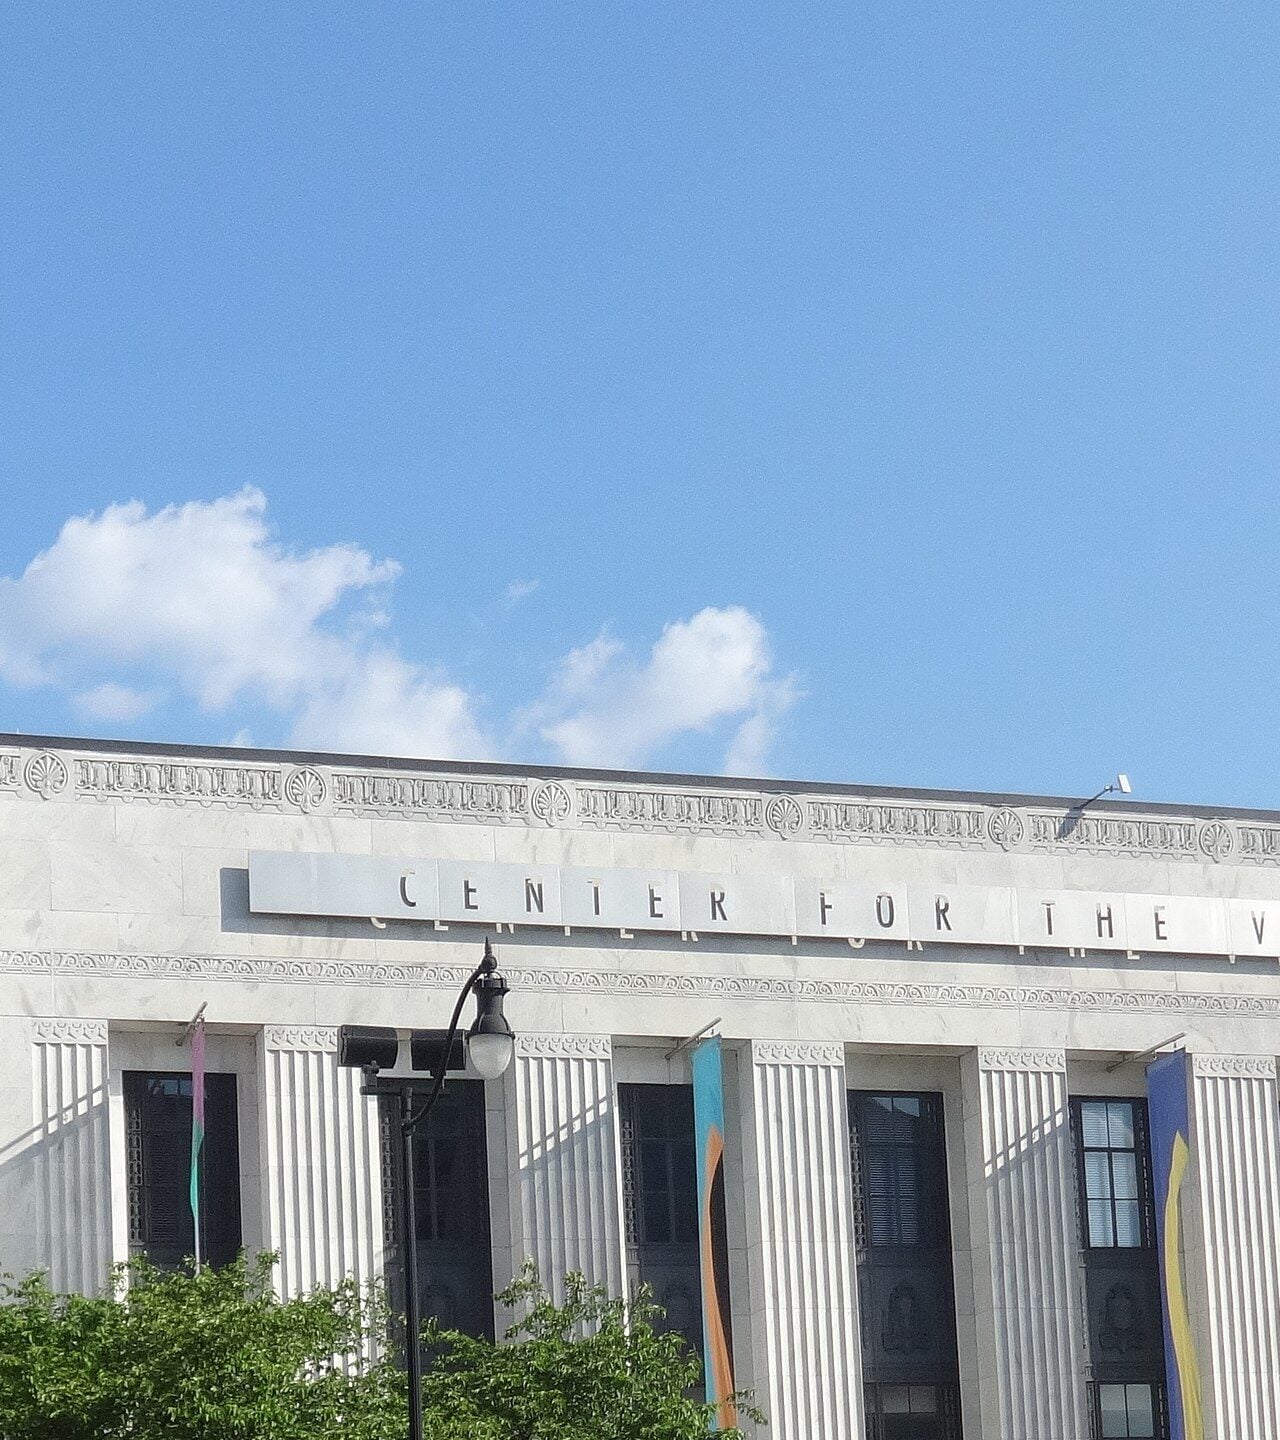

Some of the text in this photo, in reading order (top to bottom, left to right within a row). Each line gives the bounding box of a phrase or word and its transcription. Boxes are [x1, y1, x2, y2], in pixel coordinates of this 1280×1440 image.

[399, 869, 728, 922] CENTER
[818, 888, 953, 932] FOR
[1040, 899, 1168, 941] THE
